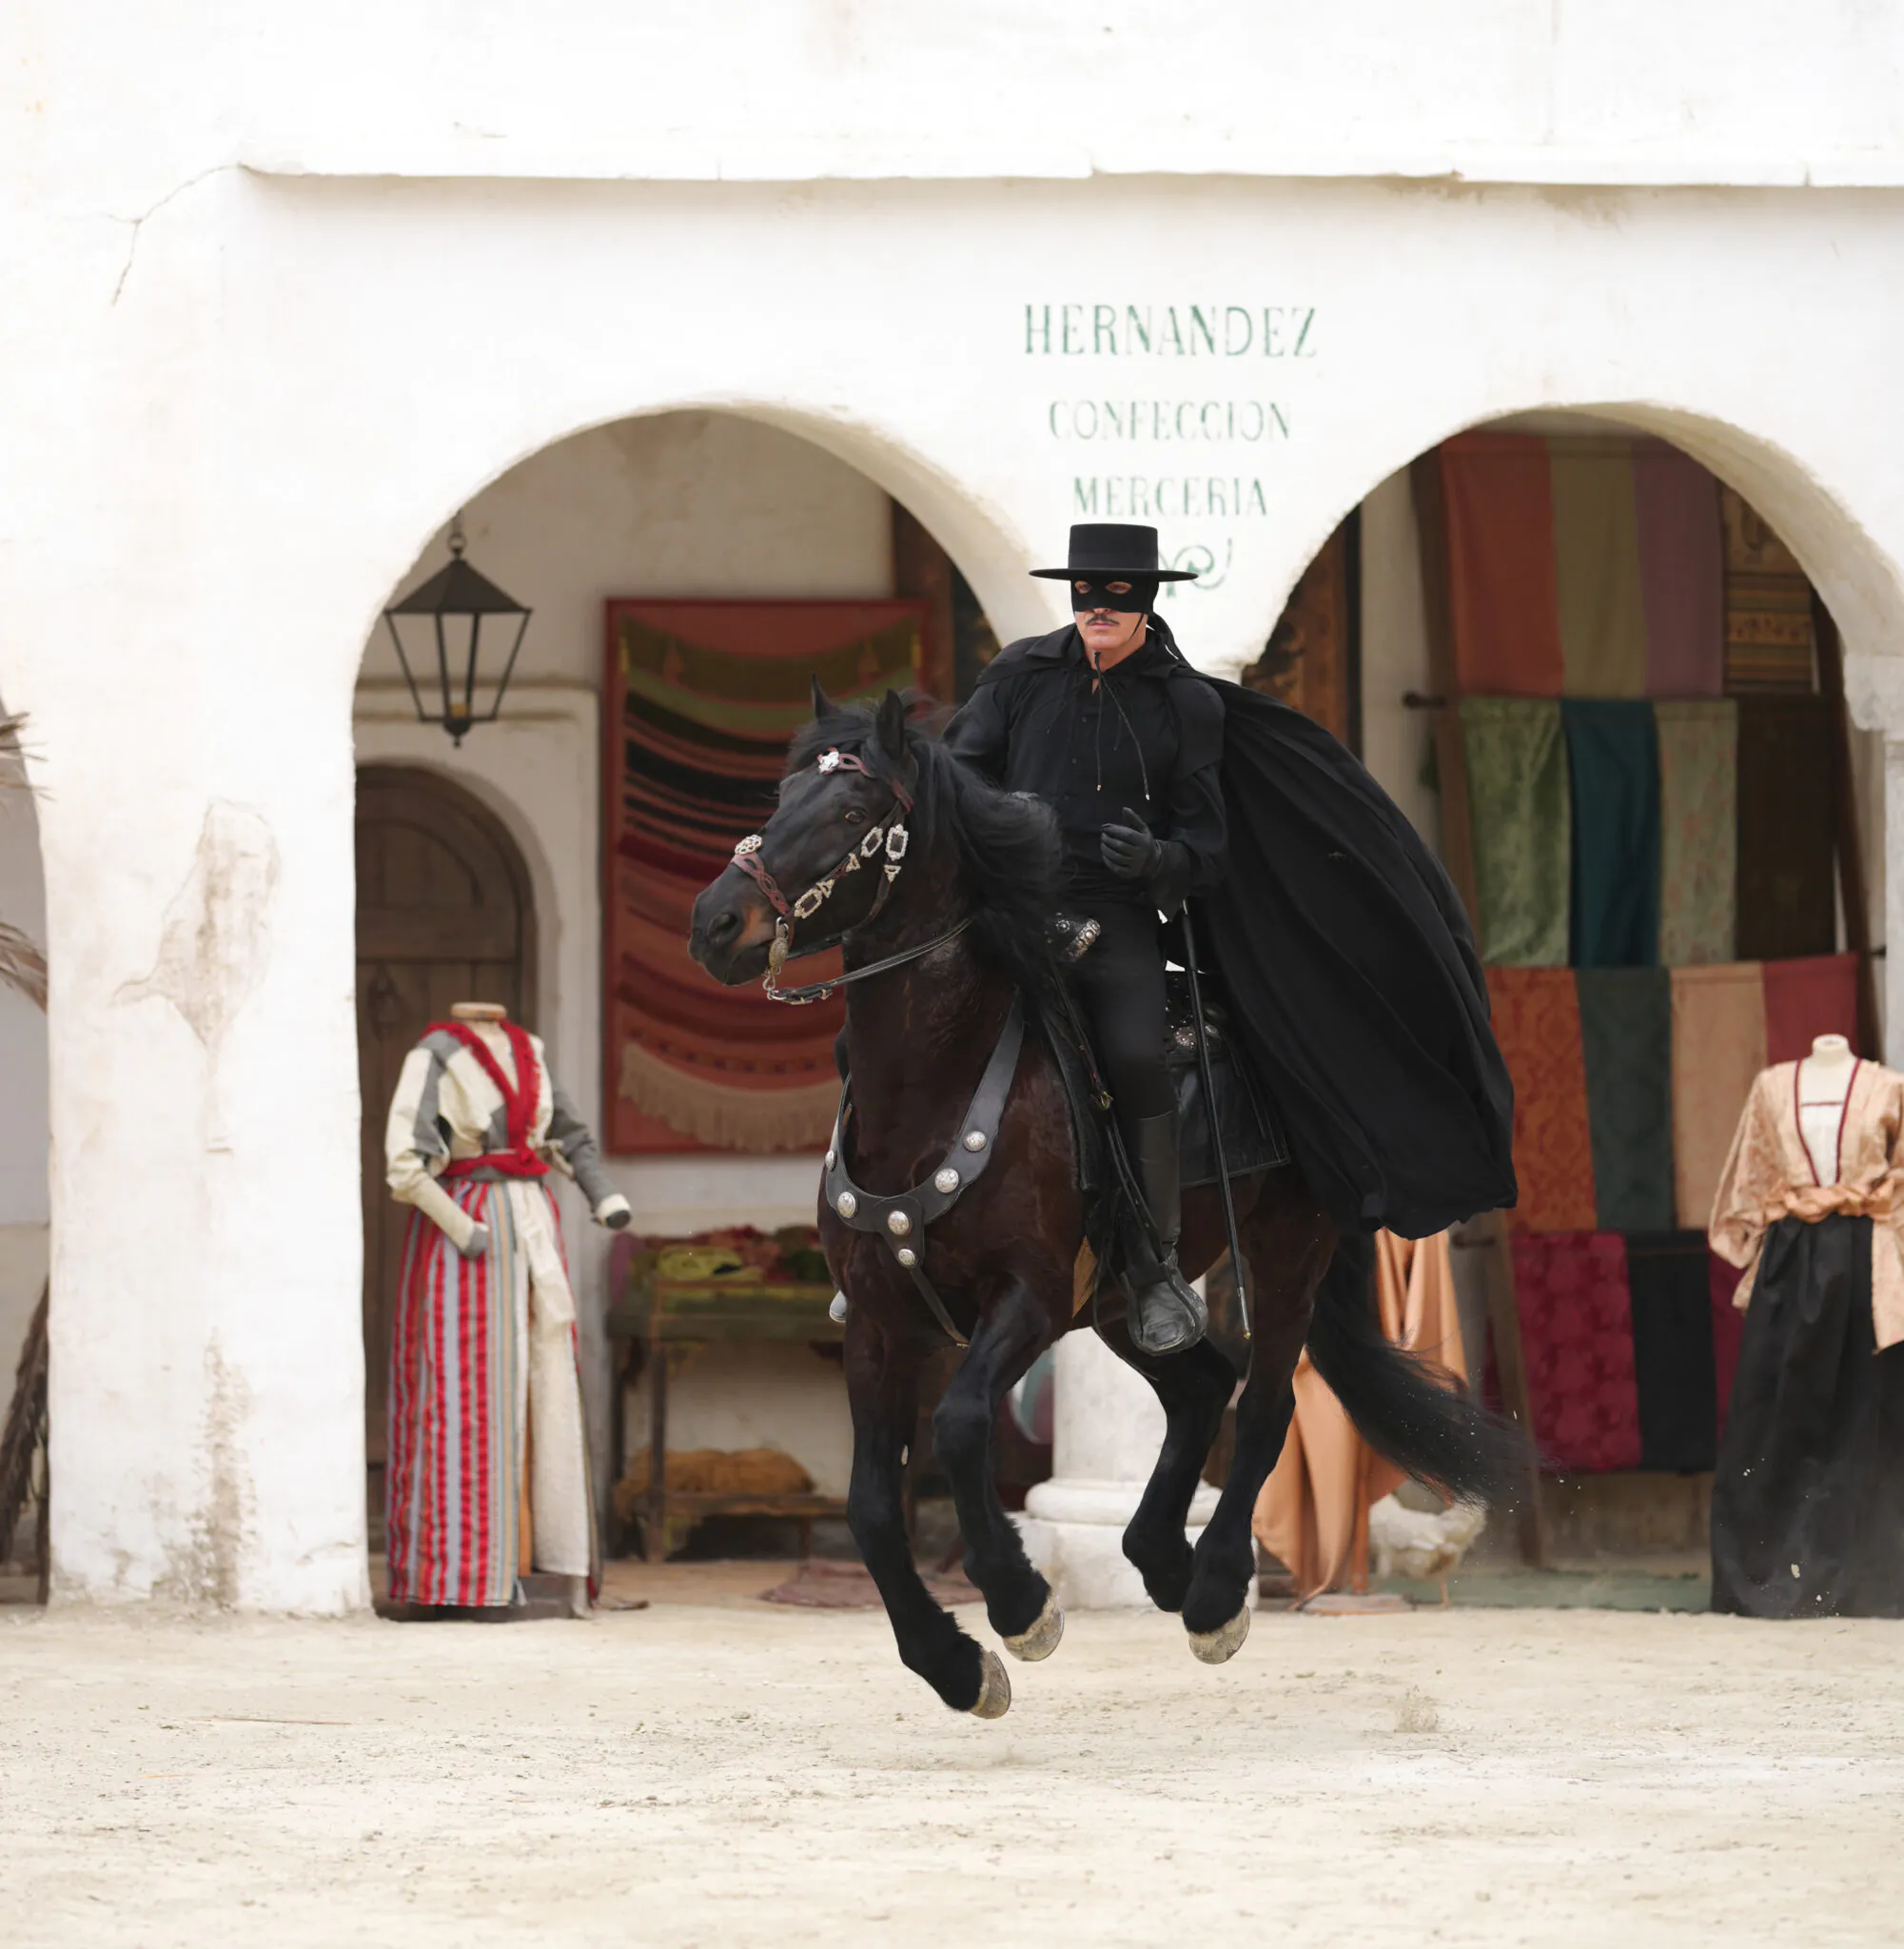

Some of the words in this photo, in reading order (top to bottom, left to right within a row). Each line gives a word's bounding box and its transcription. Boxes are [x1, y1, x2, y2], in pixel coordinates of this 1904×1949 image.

[1025, 304, 1318, 357] HERNANDEZ
[1049, 400, 1290, 441] CONFECCION
[1073, 476, 1267, 517] MERCERIA
